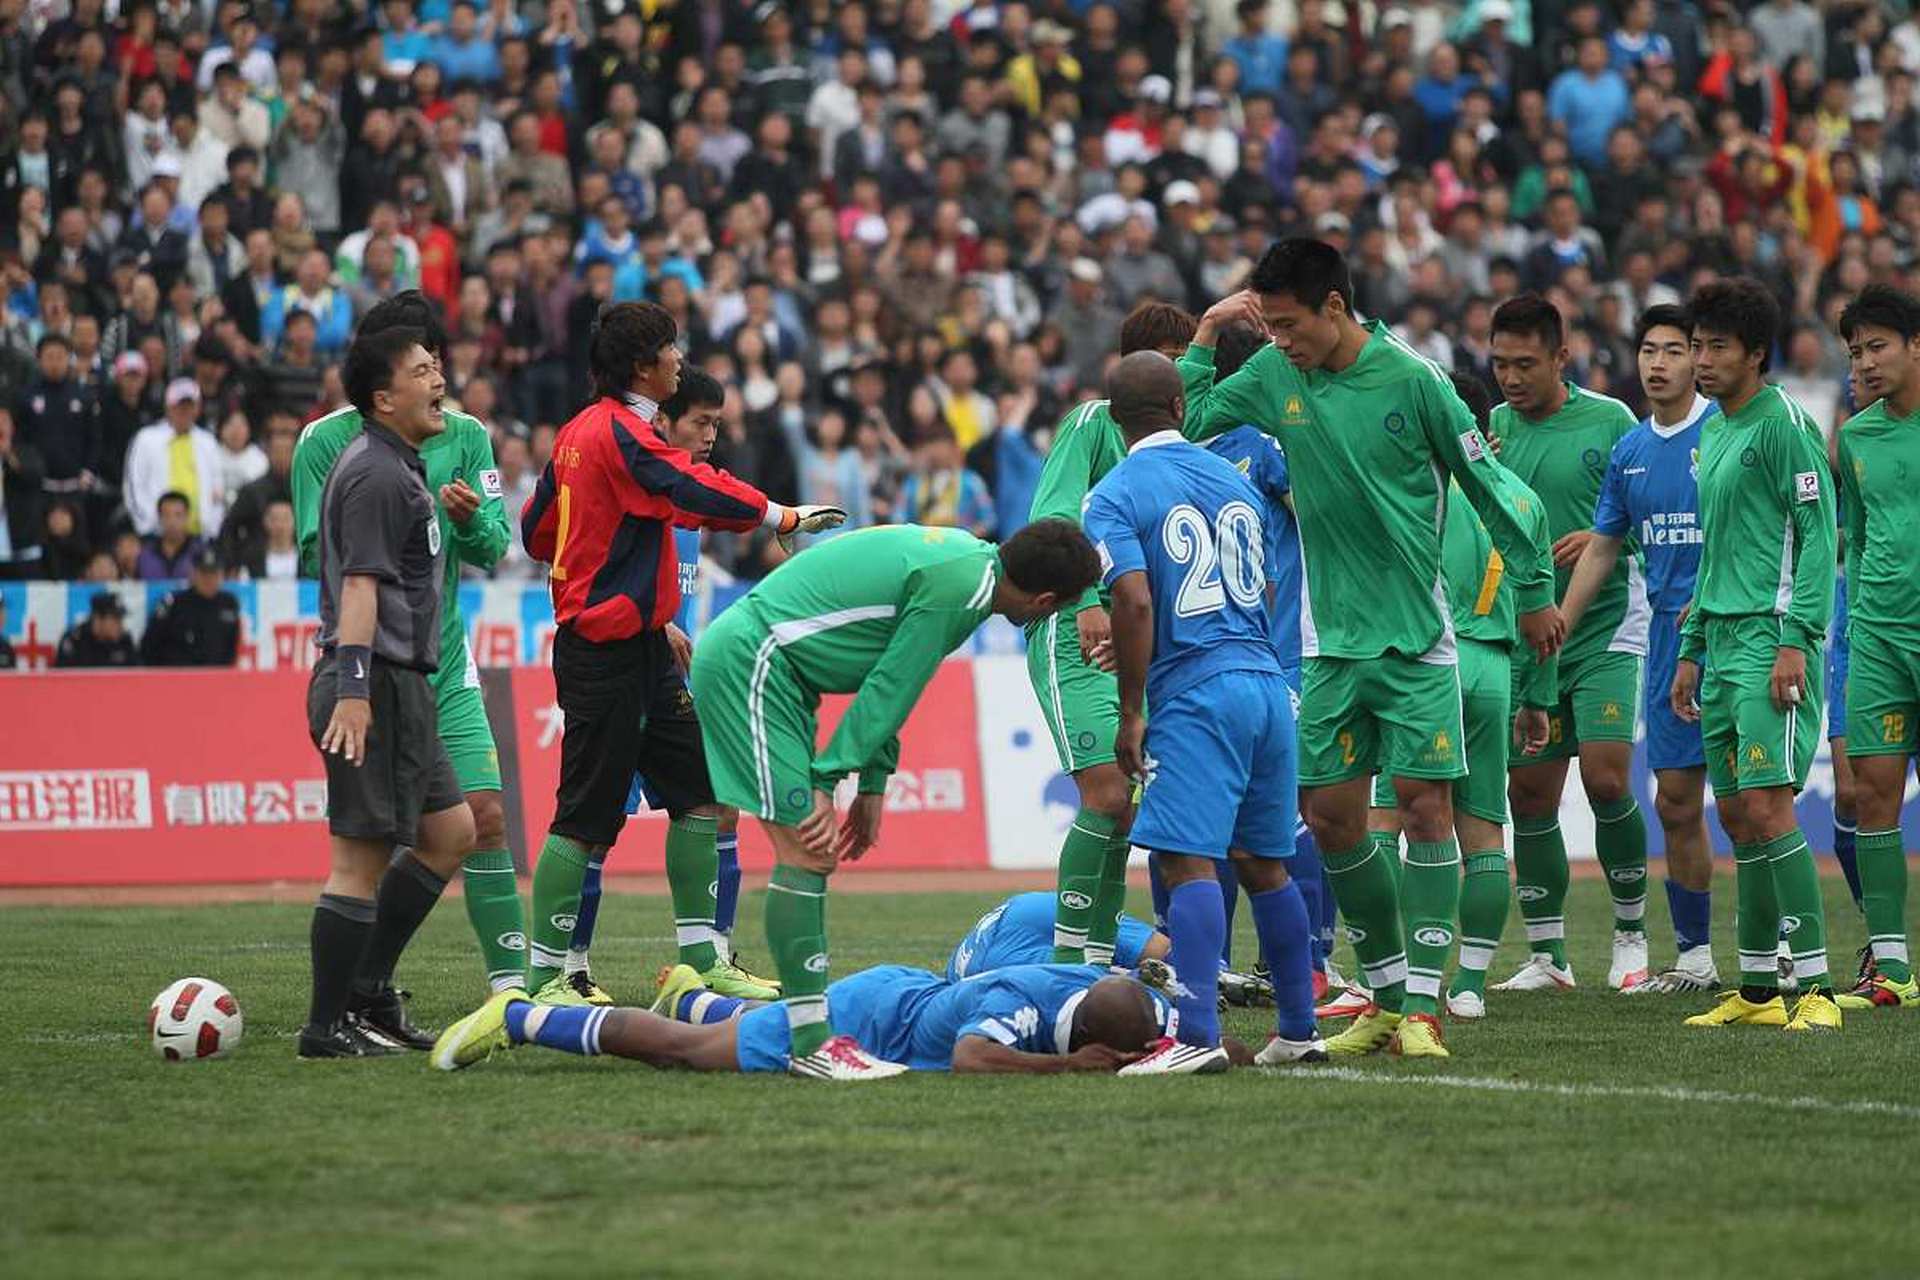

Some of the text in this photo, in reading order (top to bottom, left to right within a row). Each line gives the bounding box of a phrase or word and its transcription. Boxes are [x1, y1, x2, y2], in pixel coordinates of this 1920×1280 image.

[552, 483, 571, 580] 1
[1163, 501, 1266, 618] 20
[1339, 731, 1355, 765] 2
[163, 780, 328, 825] 有限公司
